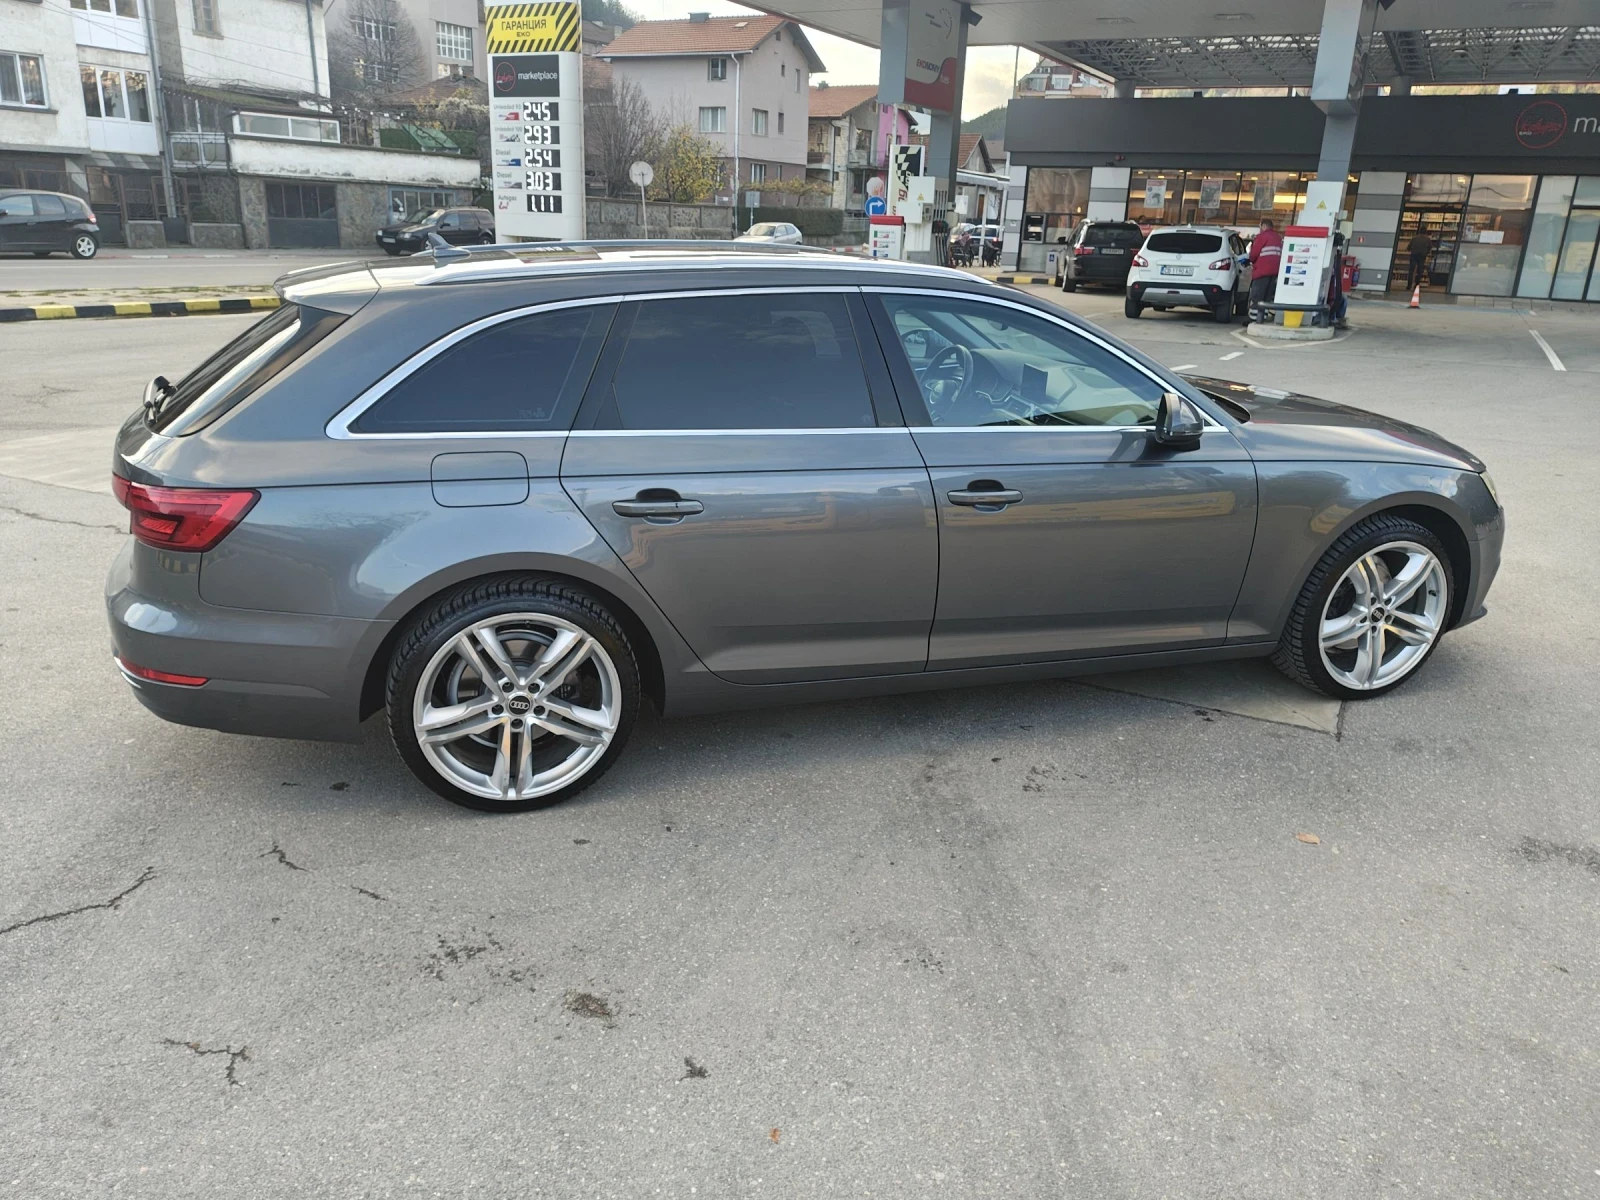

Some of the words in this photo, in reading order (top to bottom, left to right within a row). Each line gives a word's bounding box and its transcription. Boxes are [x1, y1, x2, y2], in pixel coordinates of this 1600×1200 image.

[501, 19, 547, 31] ГАРАНЦИЯ
[518, 71, 558, 81] marketplace
[523, 102, 551, 121] 2.45
[524, 125, 551, 145] 2.93
[525, 148, 552, 167] 2.54
[526, 171, 553, 190] 3.03
